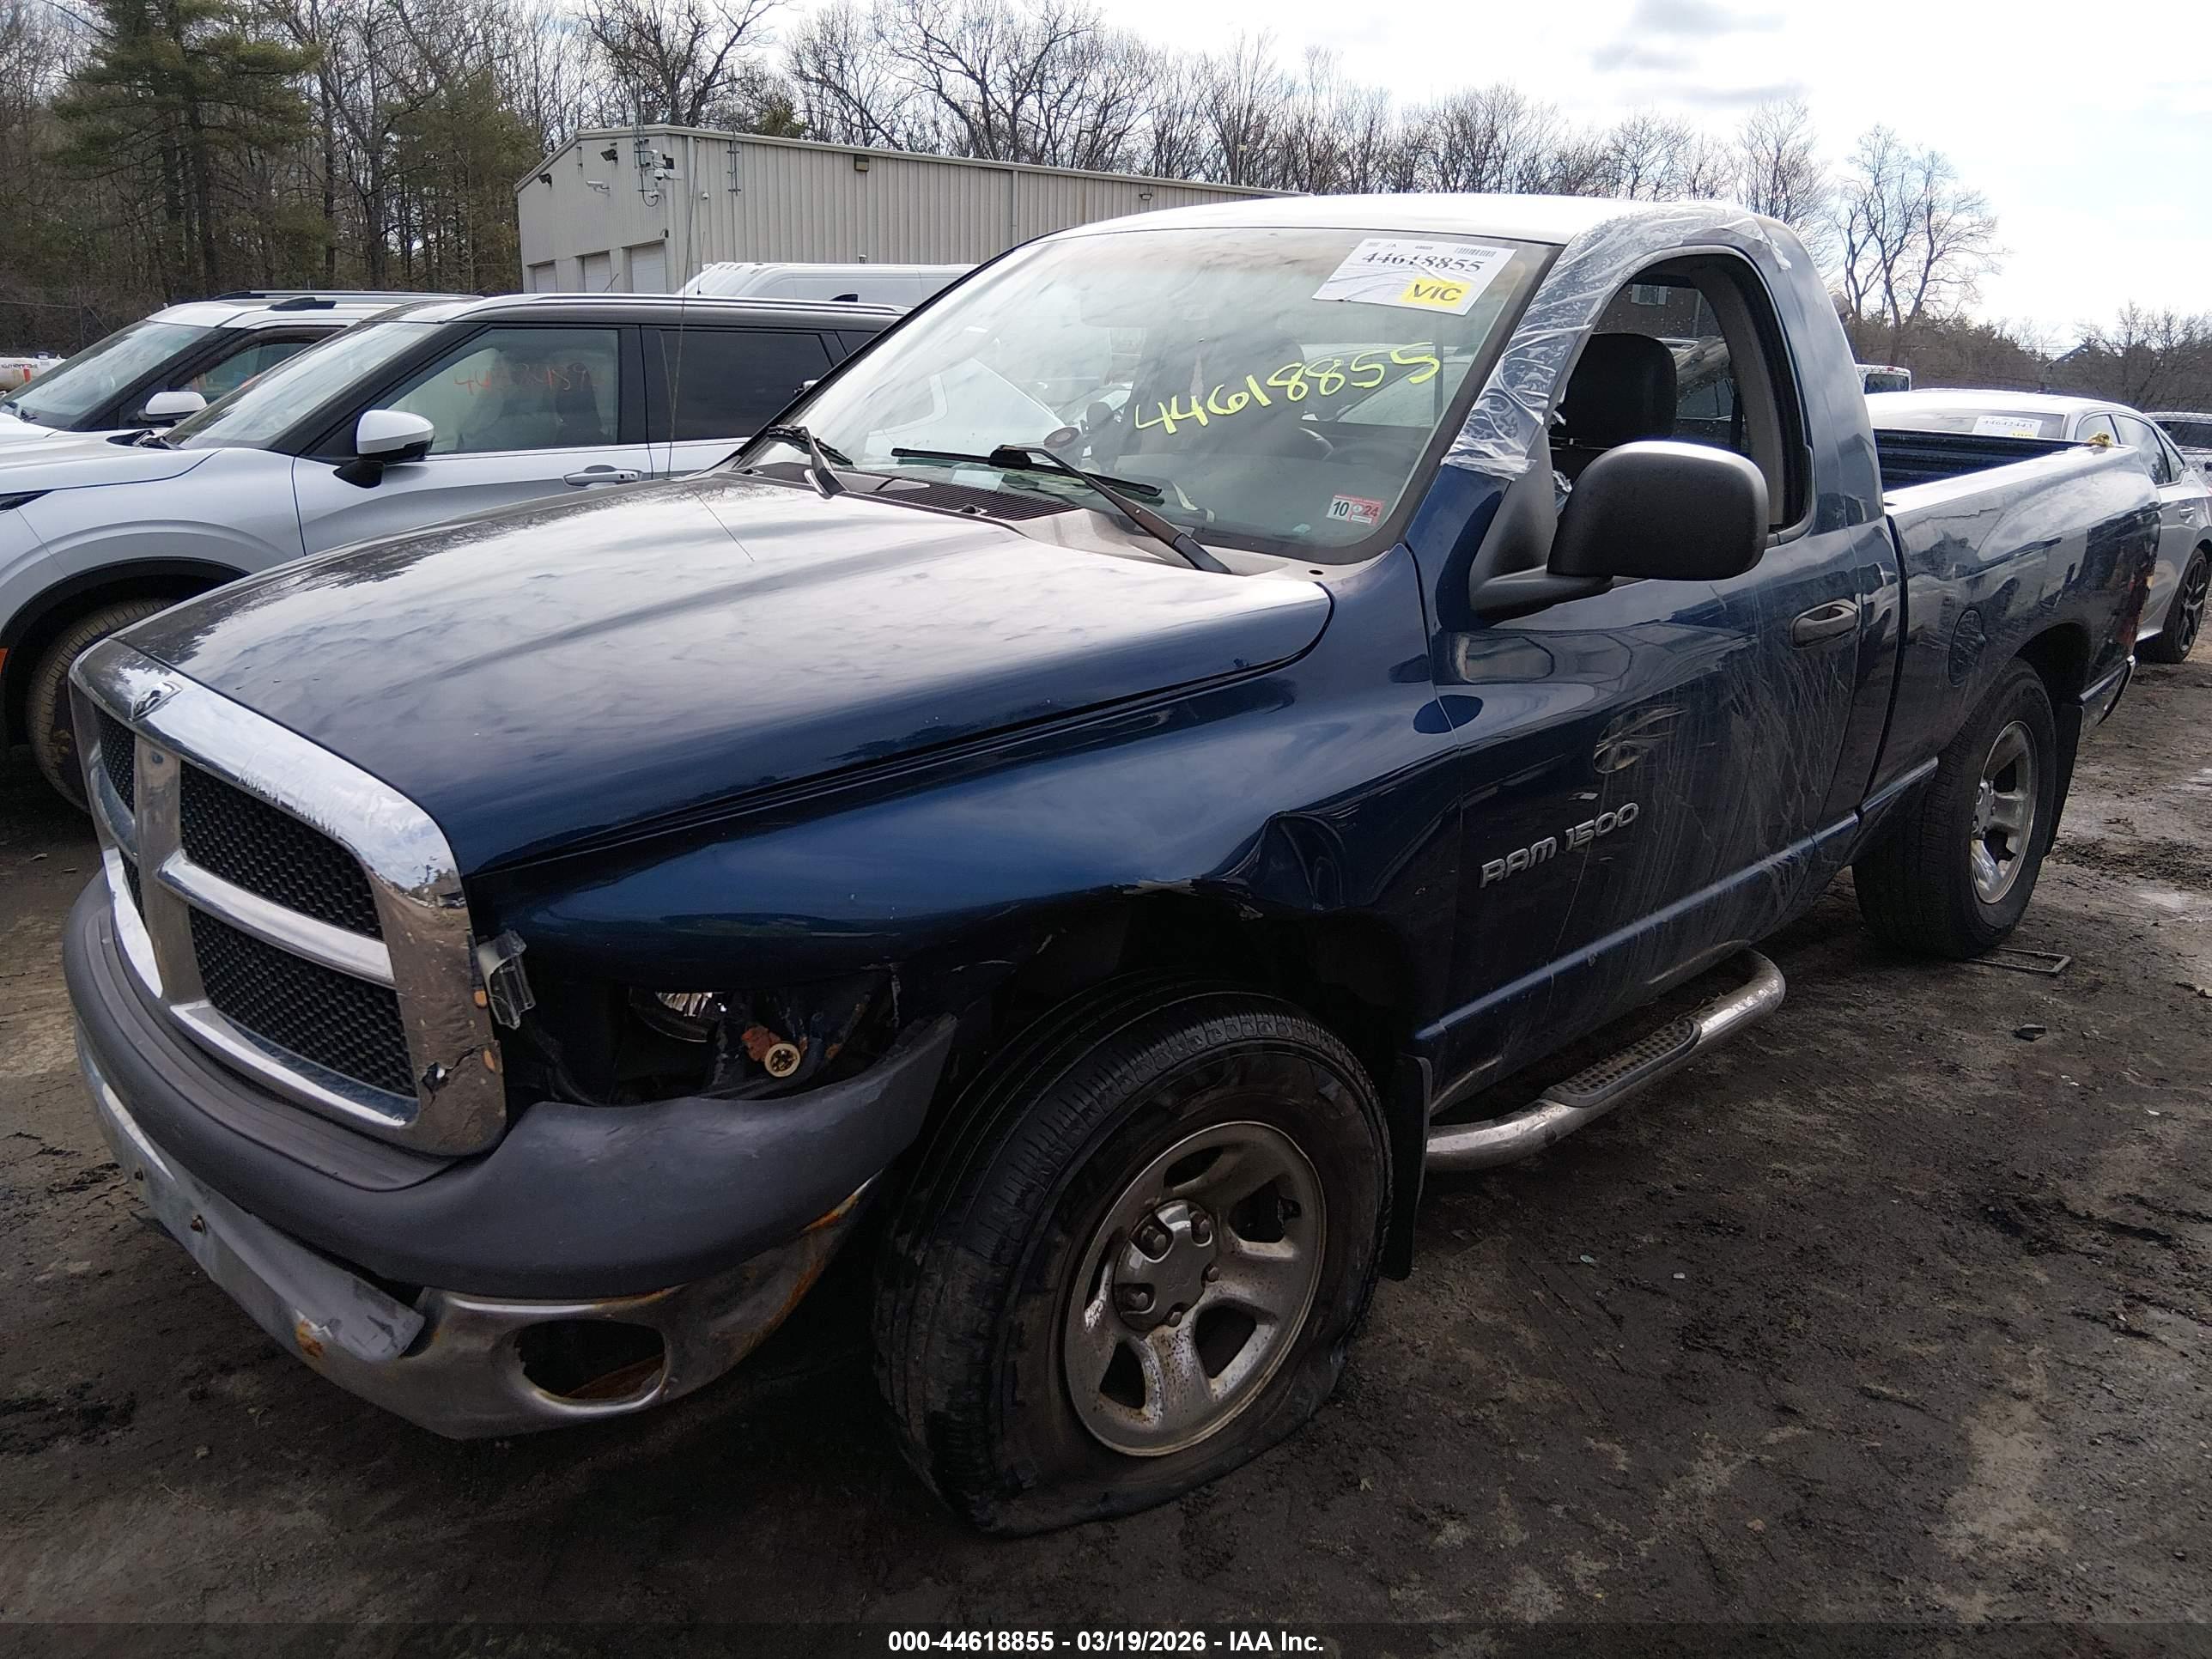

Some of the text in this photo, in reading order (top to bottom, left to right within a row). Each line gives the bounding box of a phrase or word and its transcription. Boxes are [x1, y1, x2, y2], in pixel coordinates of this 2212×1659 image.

[1413, 283, 1462, 301] VIC
[1134, 342, 1439, 434] 44618855
[1333, 501, 1379, 517] 10 24
[1479, 802, 1639, 888] RAM 1500
